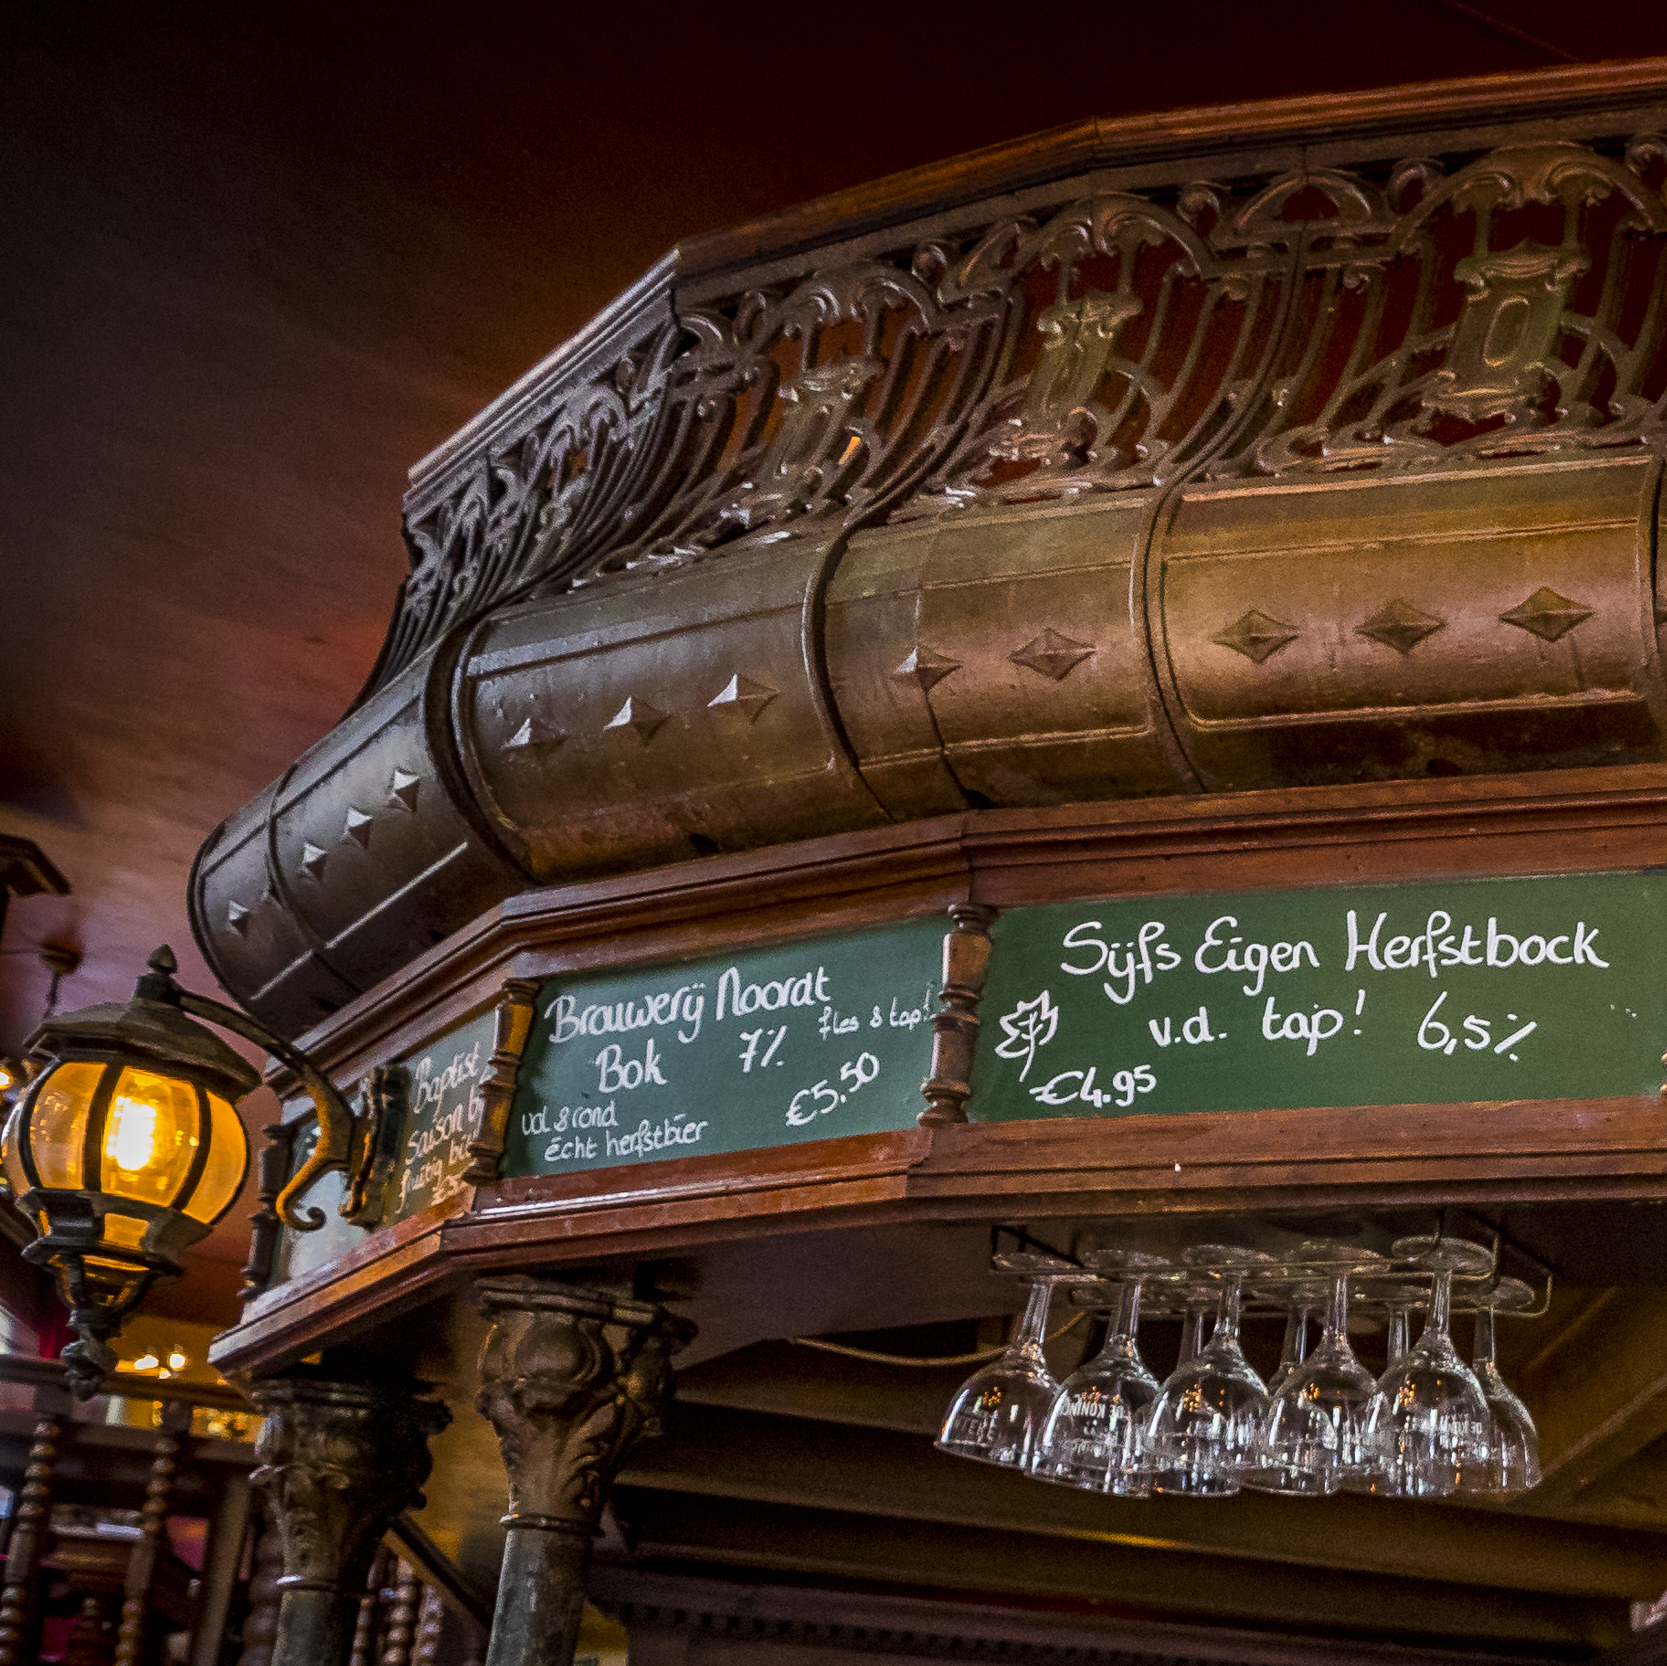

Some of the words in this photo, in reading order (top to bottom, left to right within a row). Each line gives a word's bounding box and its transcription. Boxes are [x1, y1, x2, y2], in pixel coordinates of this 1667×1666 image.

[1193, 915, 1320, 996] Eigen
[1344, 909, 1611, 979] Herfstbock
[543, 982, 706, 1046] Brouwerij
[715, 965, 832, 1022] Noordt
[1148, 1006, 1228, 1047] v.d.
[1416, 991, 1538, 1061] 6,5%
[595, 1038, 668, 1094] Bok
[737, 1025, 787, 1074] 7%
[571, 1099, 619, 1130] rond
[606, 1113, 710, 1160] herfstbier
